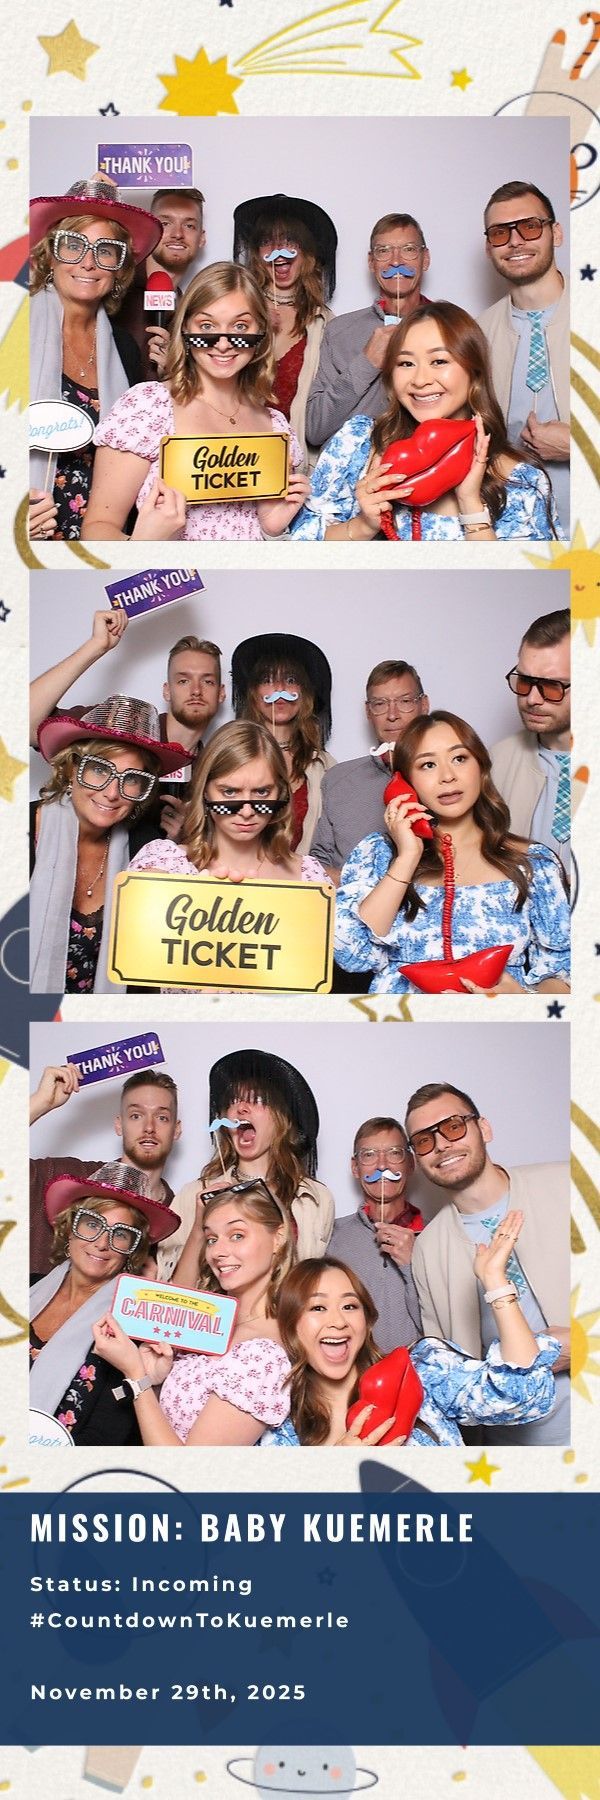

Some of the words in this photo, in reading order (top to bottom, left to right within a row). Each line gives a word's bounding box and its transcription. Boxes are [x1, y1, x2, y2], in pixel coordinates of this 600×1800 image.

[104, 157, 152, 174] THANK
[155, 156, 188, 174] YOU!
[146, 295, 172, 306] NEWS
[29, 415, 85, 440] ongrats!
[193, 445, 259, 472] Golden
[192, 471, 261, 490] TICKET
[114, 580, 163, 608] THANK
[165, 894, 280, 936] Golden
[161, 938, 281, 970] TICKET
[123, 1041, 158, 1061] YOU!
[156, 1293, 179, 1302] WELCOME
[121, 1298, 224, 1336] CARNIVAL
